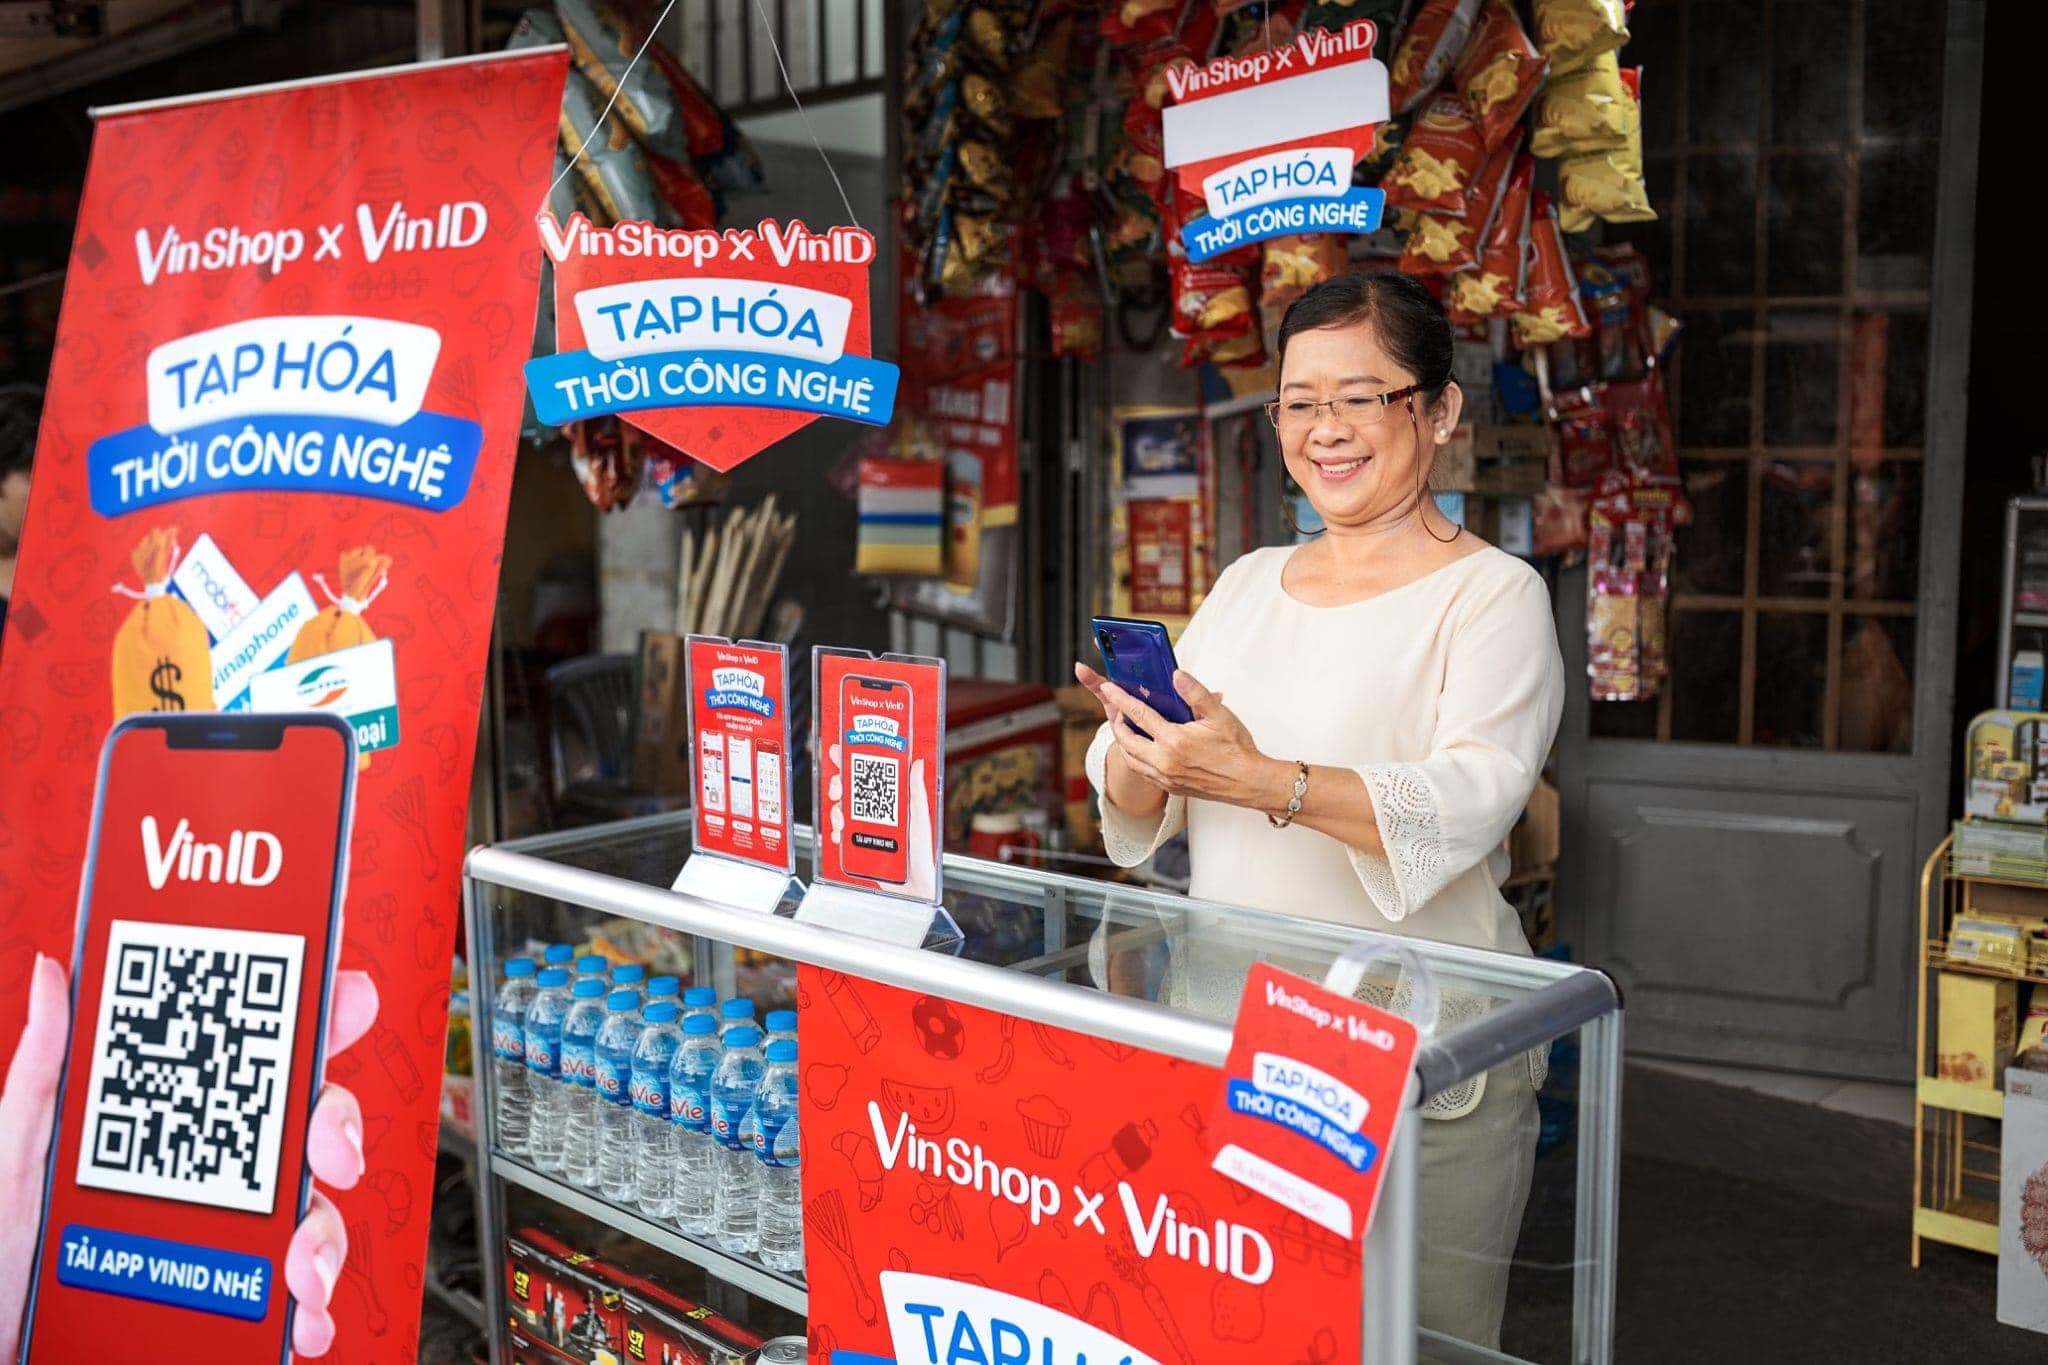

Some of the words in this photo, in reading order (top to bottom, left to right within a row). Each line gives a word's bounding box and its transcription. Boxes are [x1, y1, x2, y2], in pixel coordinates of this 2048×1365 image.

[1166, 55, 1270, 100] VinShop
[1275, 48, 1293, 71] x
[1298, 22, 1374, 67] VinID
[1273, 152, 1337, 189] HÓA
[134, 224, 303, 286] VinShop
[314, 223, 343, 259] x
[356, 201, 487, 264] VinID
[540, 216, 719, 268] VinShop
[728, 234, 755, 262] x
[763, 222, 872, 268] VinID
[1194, 219, 1243, 254] THỜI
[1245, 205, 1304, 236] CÔNG
[1309, 200, 1369, 228] NGHỆ
[598, 295, 701, 342] TẠP
[713, 289, 824, 348] HÓA
[165, 342, 264, 408] TẠP
[273, 325, 397, 402] HÓA
[555, 361, 651, 411] THỜI
[659, 357, 766, 396] CÔNG
[777, 366, 875, 416] NGHỆ
[111, 434, 198, 502] THỜI
[206, 426, 324, 477] CÔNG
[331, 436, 453, 502] NGHỆ
[358, 715, 387, 748] oại
[141, 815, 283, 890] VinID
[867, 1100, 1061, 1227] VinShop
[1072, 1185, 1105, 1235] x
[1118, 1180, 1275, 1286] VinID
[65, 1236, 98, 1269] TẢI
[99, 1248, 143, 1280] APP
[148, 1257, 211, 1292] VINID
[213, 1265, 265, 1301] NHÉ
